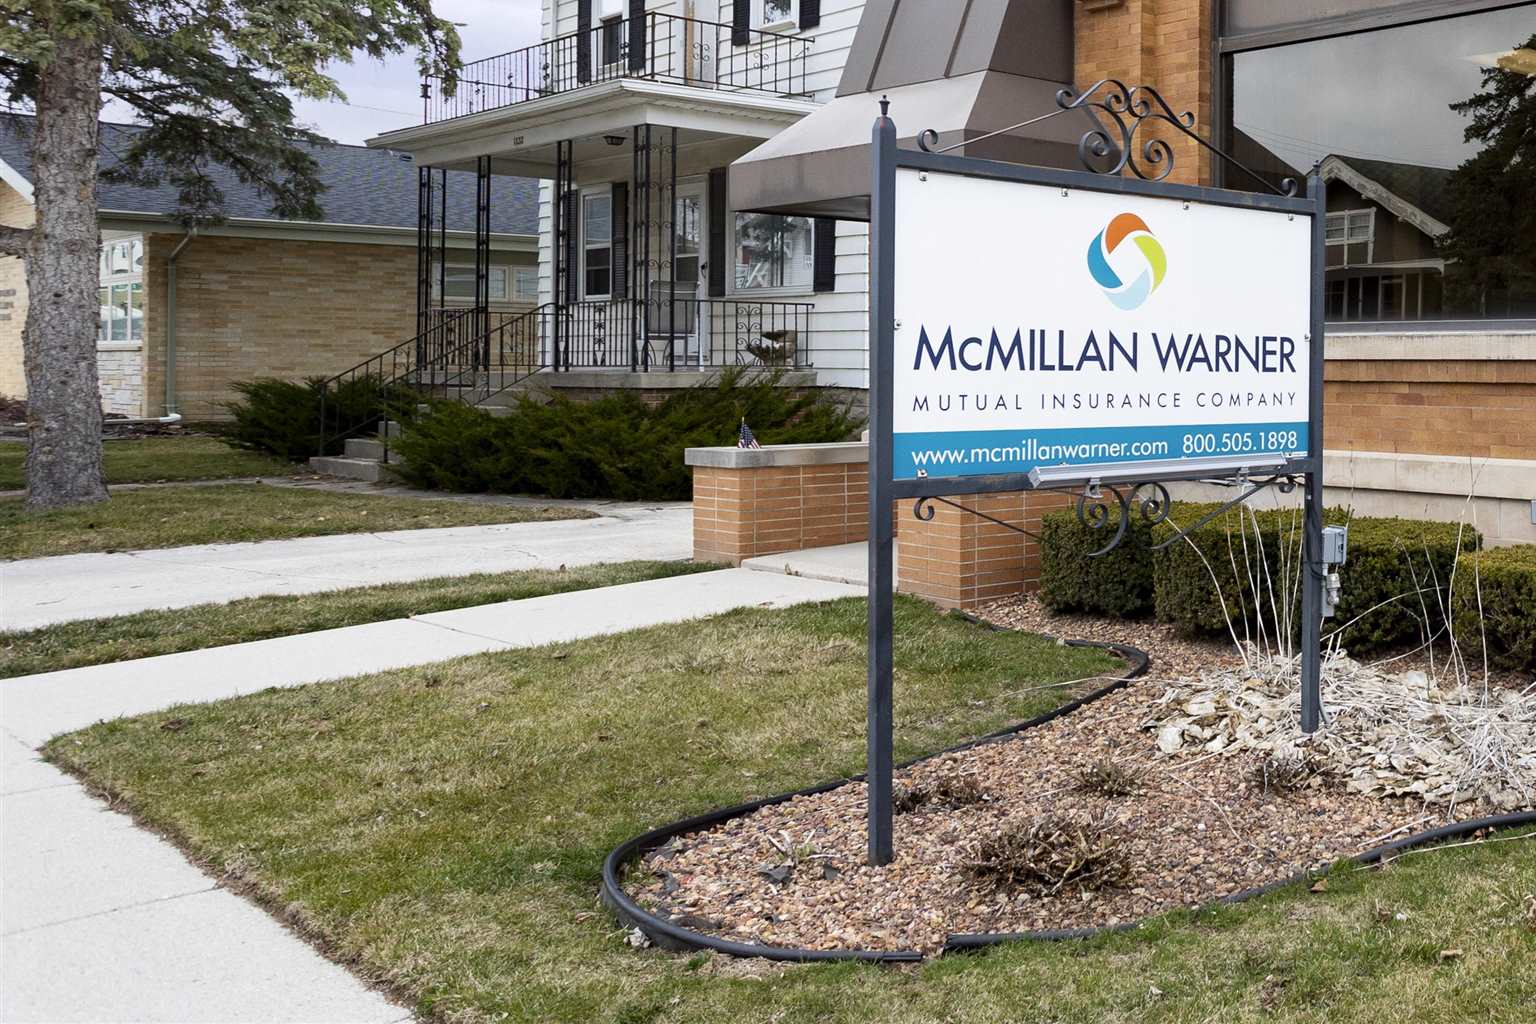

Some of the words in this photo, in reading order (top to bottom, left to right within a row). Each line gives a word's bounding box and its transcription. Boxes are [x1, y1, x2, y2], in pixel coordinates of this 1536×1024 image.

[1151, 332, 1297, 373] WARNER
[912, 394, 1023, 412] MUTUAL
[1041, 392, 1181, 410] INSURANCE
[1196, 391, 1296, 408] COMPANY
[911, 438, 1168, 466] www.mcmillanwarner.com
[1182, 430, 1298, 455] 800.505.1898
